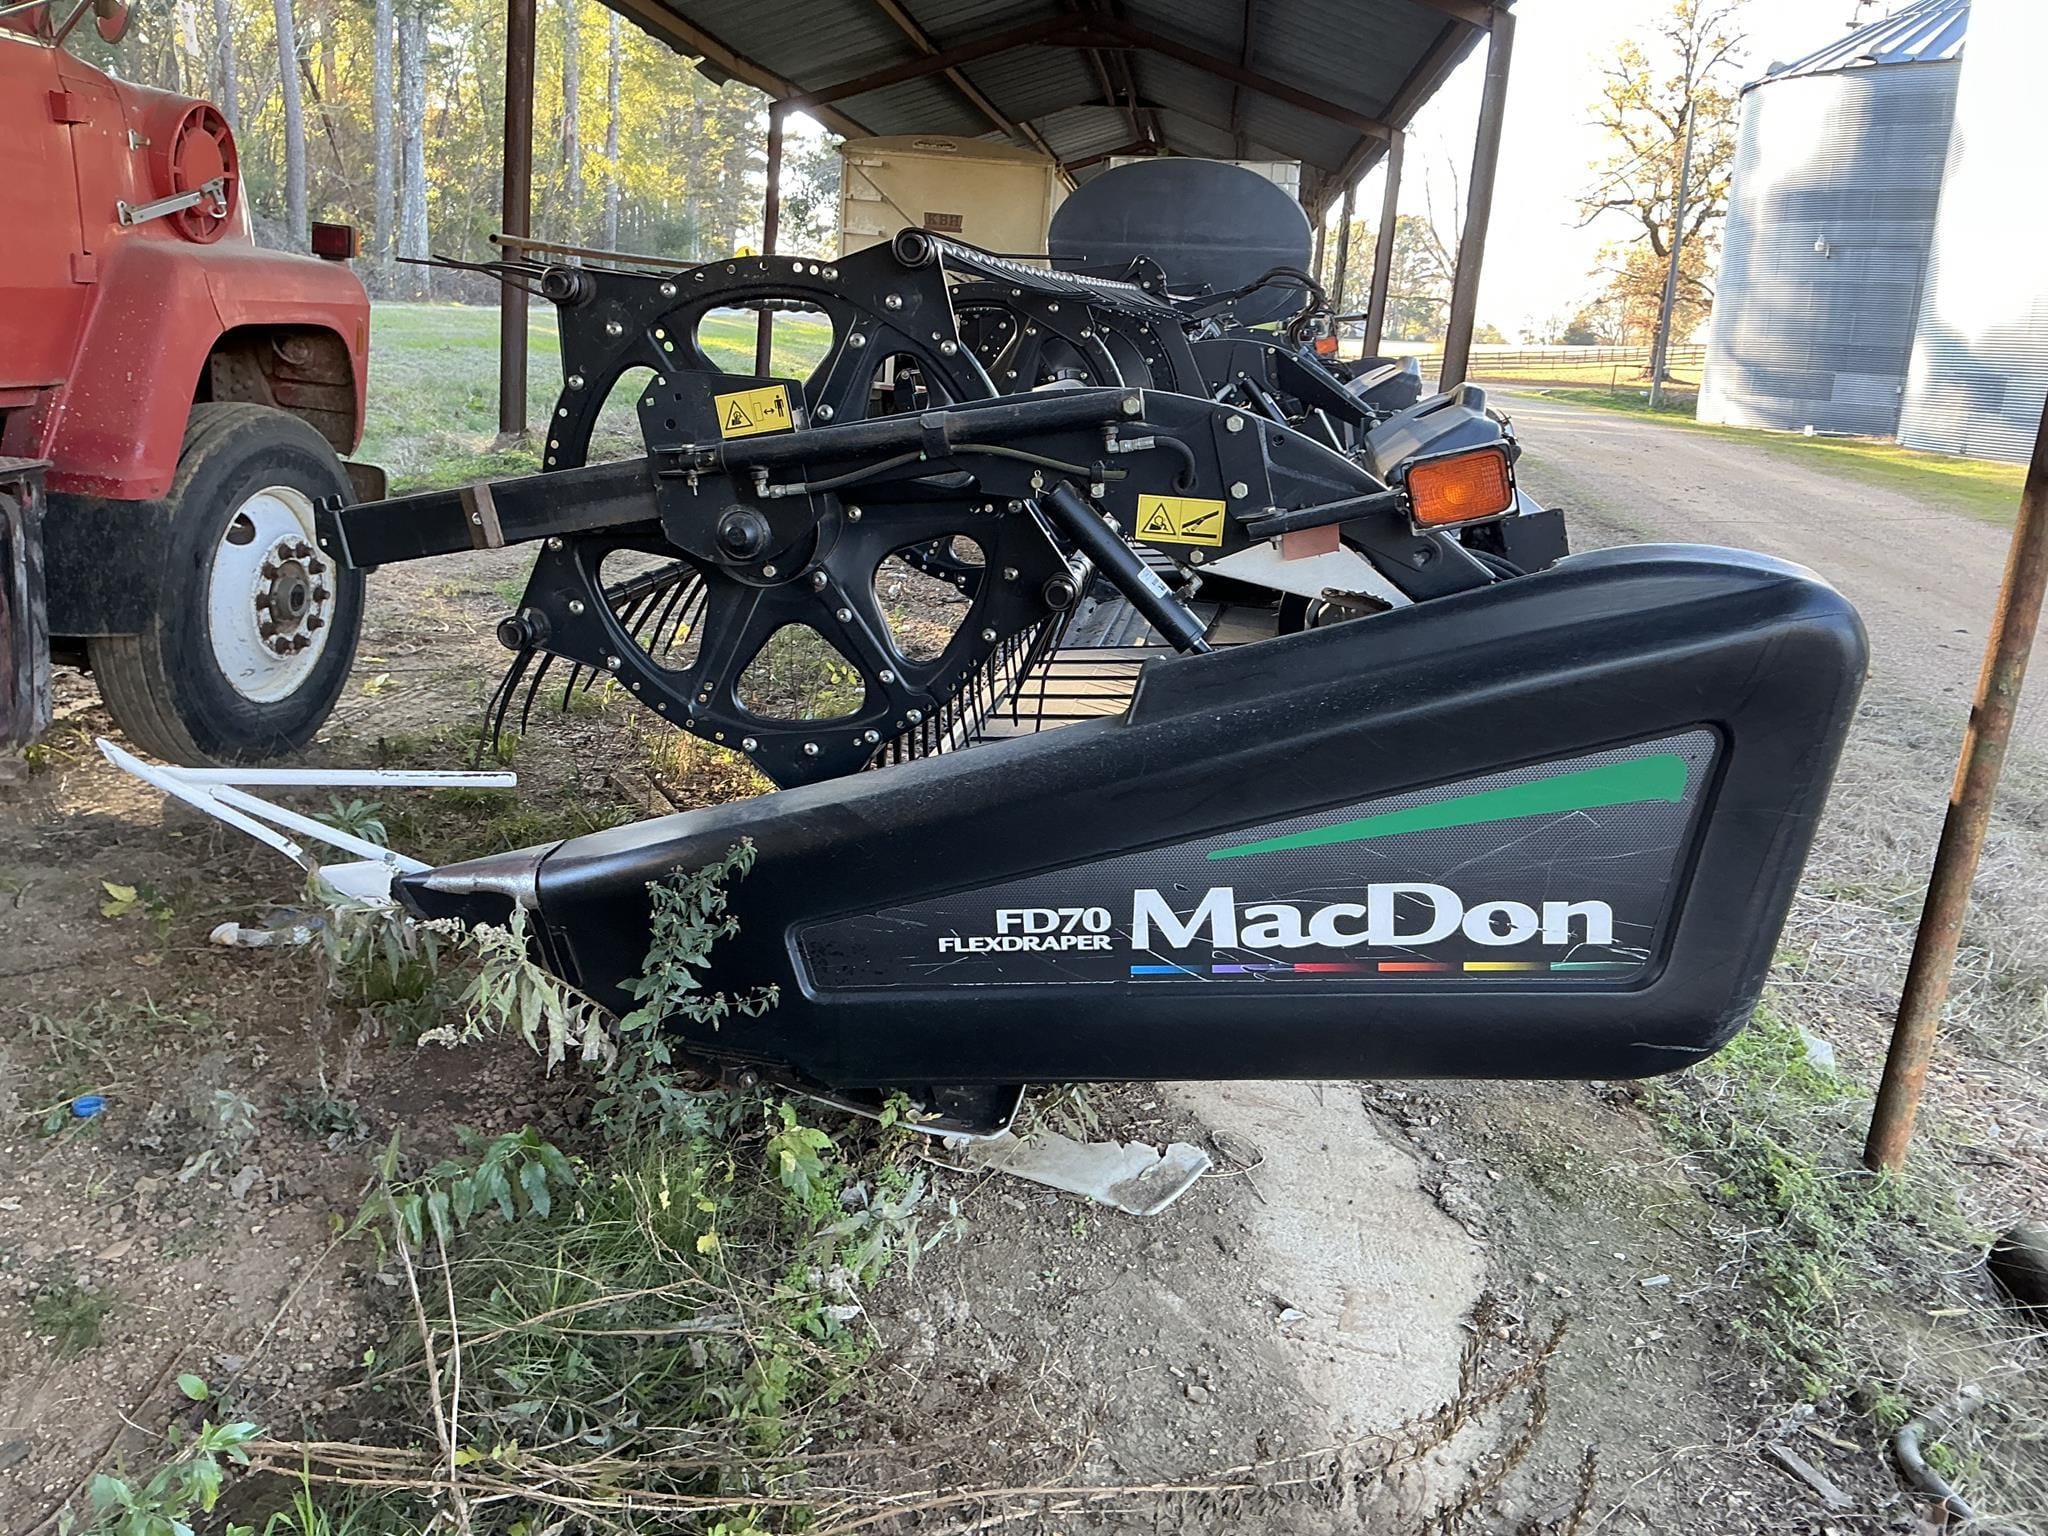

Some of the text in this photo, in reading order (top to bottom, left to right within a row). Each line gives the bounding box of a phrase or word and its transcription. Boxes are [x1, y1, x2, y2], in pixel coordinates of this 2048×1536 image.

[926, 213, 961, 226] KBH
[996, 907, 1112, 934] FD70
[1131, 883, 1613, 949] MacDon
[938, 935, 1112, 952] FLEXDRAPER
